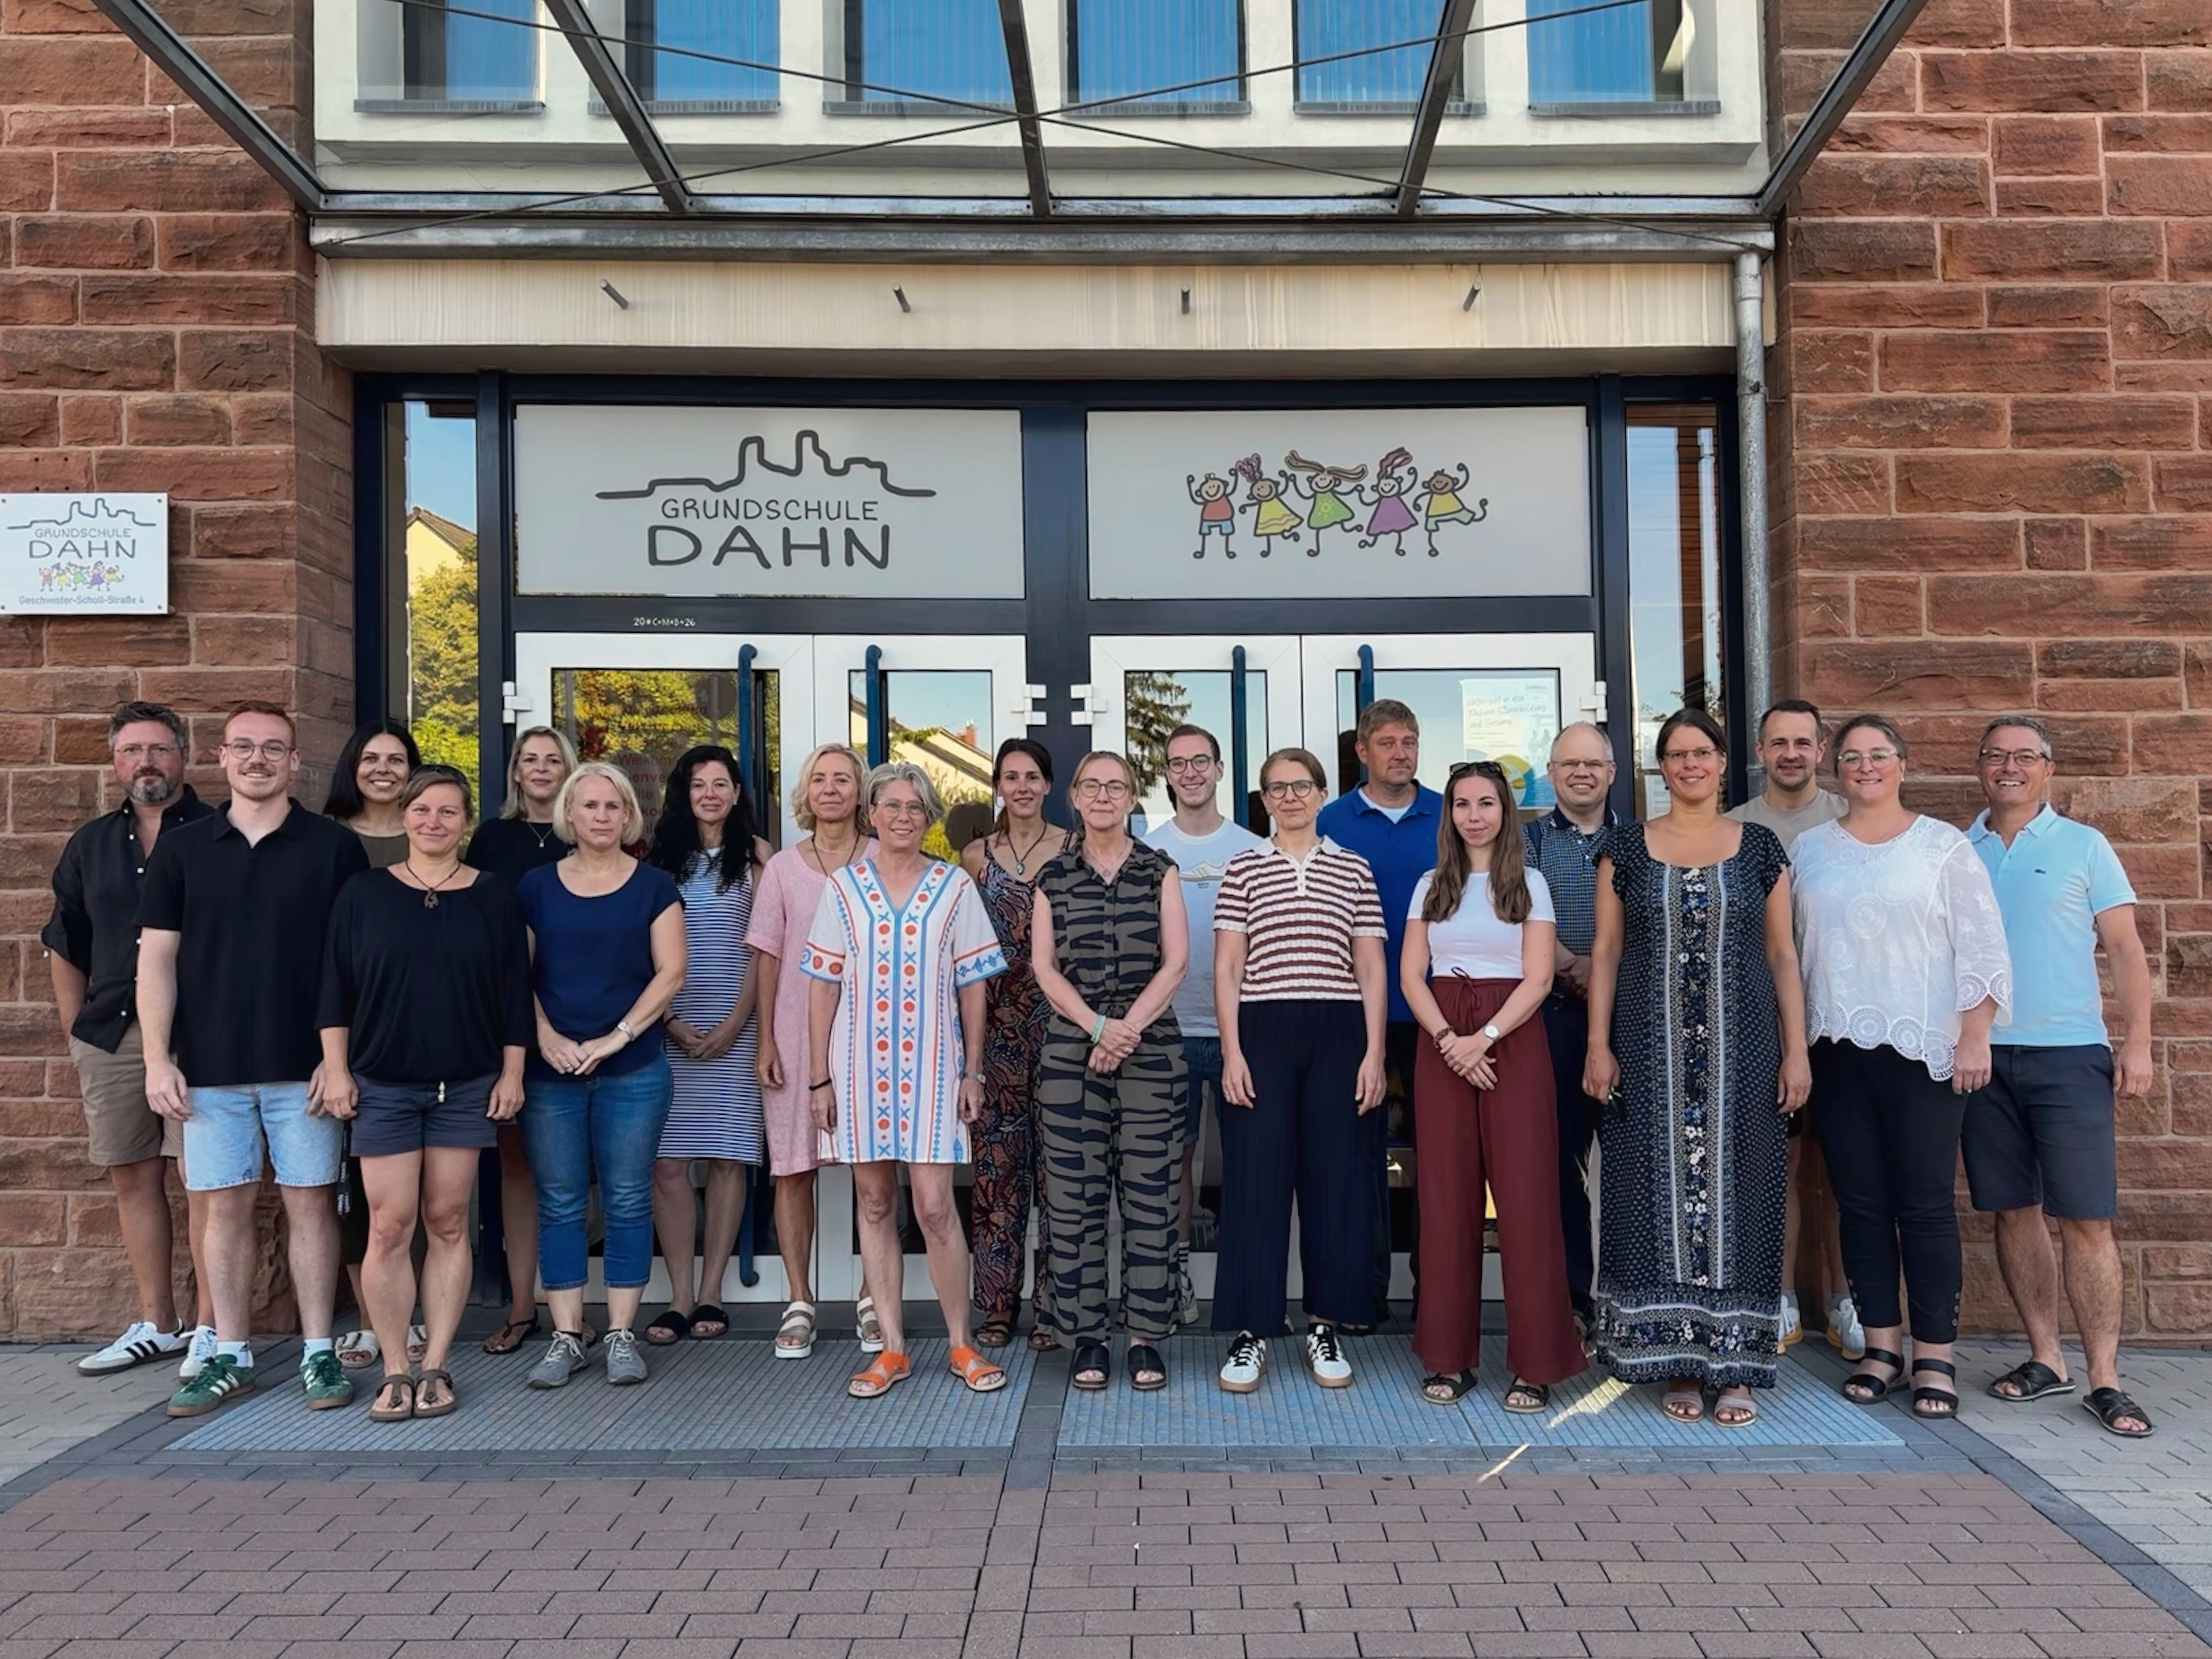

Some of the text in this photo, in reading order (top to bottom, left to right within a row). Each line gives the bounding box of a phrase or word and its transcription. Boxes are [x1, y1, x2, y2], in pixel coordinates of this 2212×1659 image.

[662, 498, 878, 521] GRUNDSCHULE
[35, 528, 132, 538] GRUNDSCHULE
[29, 539, 136, 559] DAHN
[648, 525, 890, 569] DAHN
[138, 596, 144, 604] 4
[618, 754, 672, 765] Welkom
